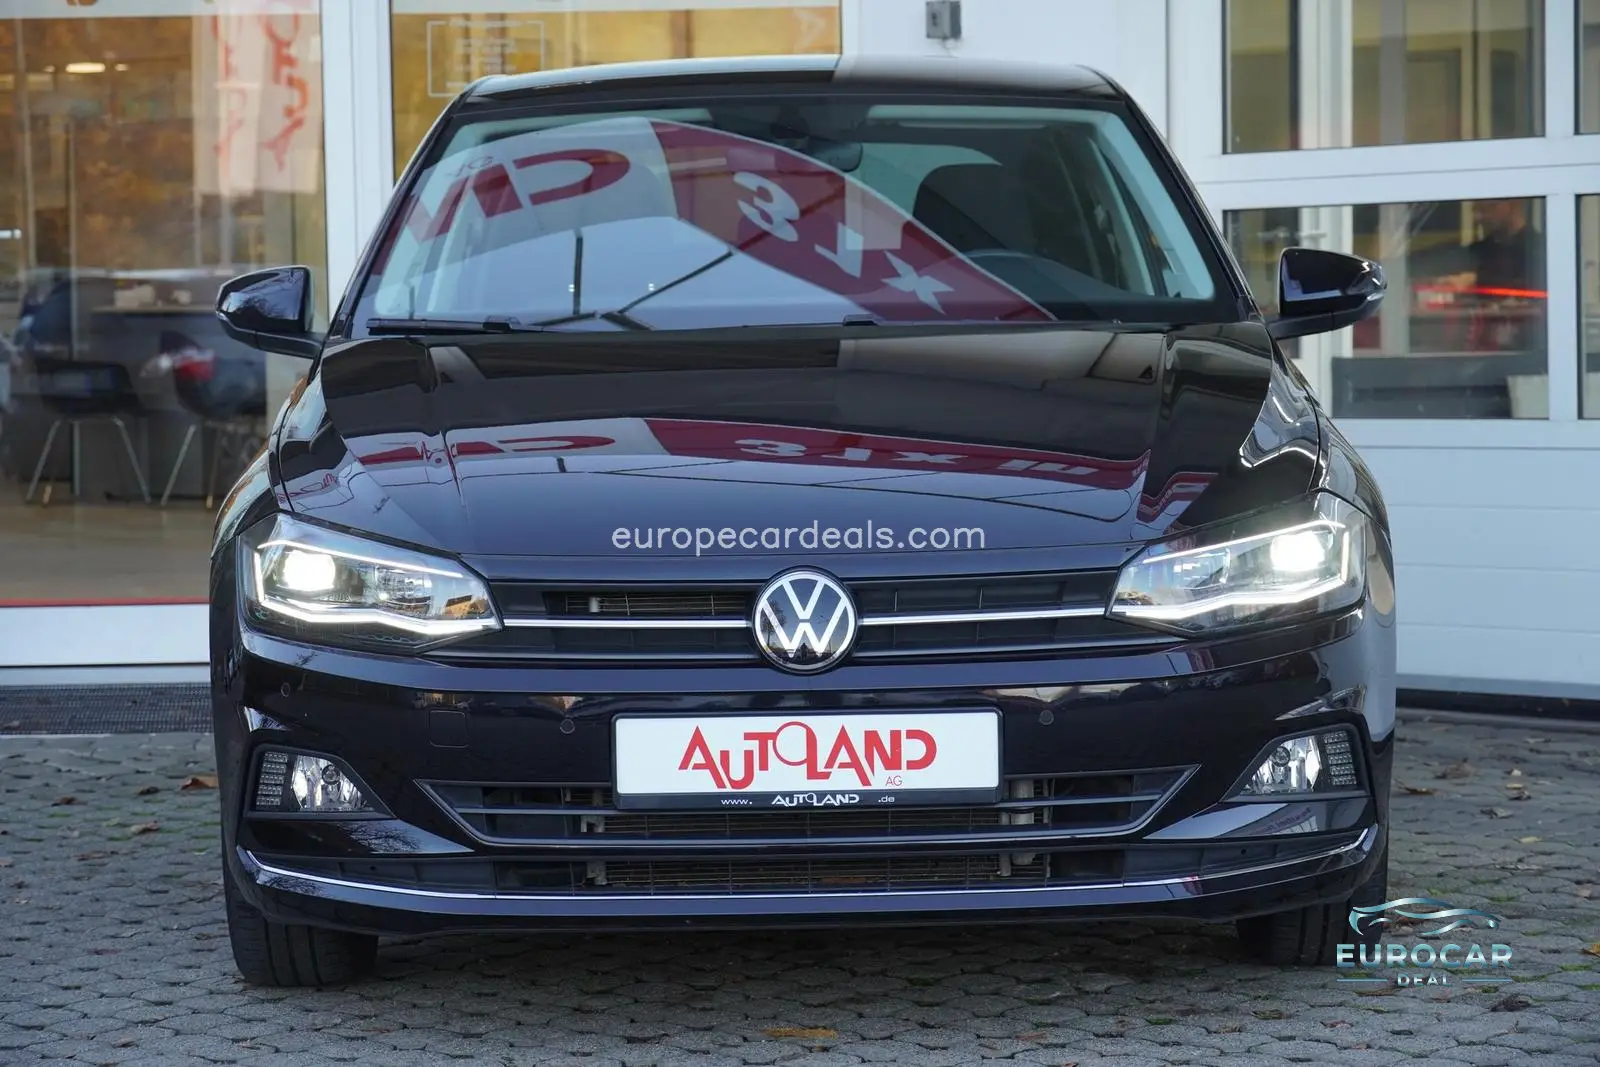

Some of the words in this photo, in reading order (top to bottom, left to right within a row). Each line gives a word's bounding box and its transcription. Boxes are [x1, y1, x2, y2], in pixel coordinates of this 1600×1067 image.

[760, 577, 849, 661] VW
[678, 720, 938, 791] AUTOLAND
[771, 792, 860, 807] AUTOLAND
[877, 795, 896, 804] .de
[885, 775, 903, 788] AG
